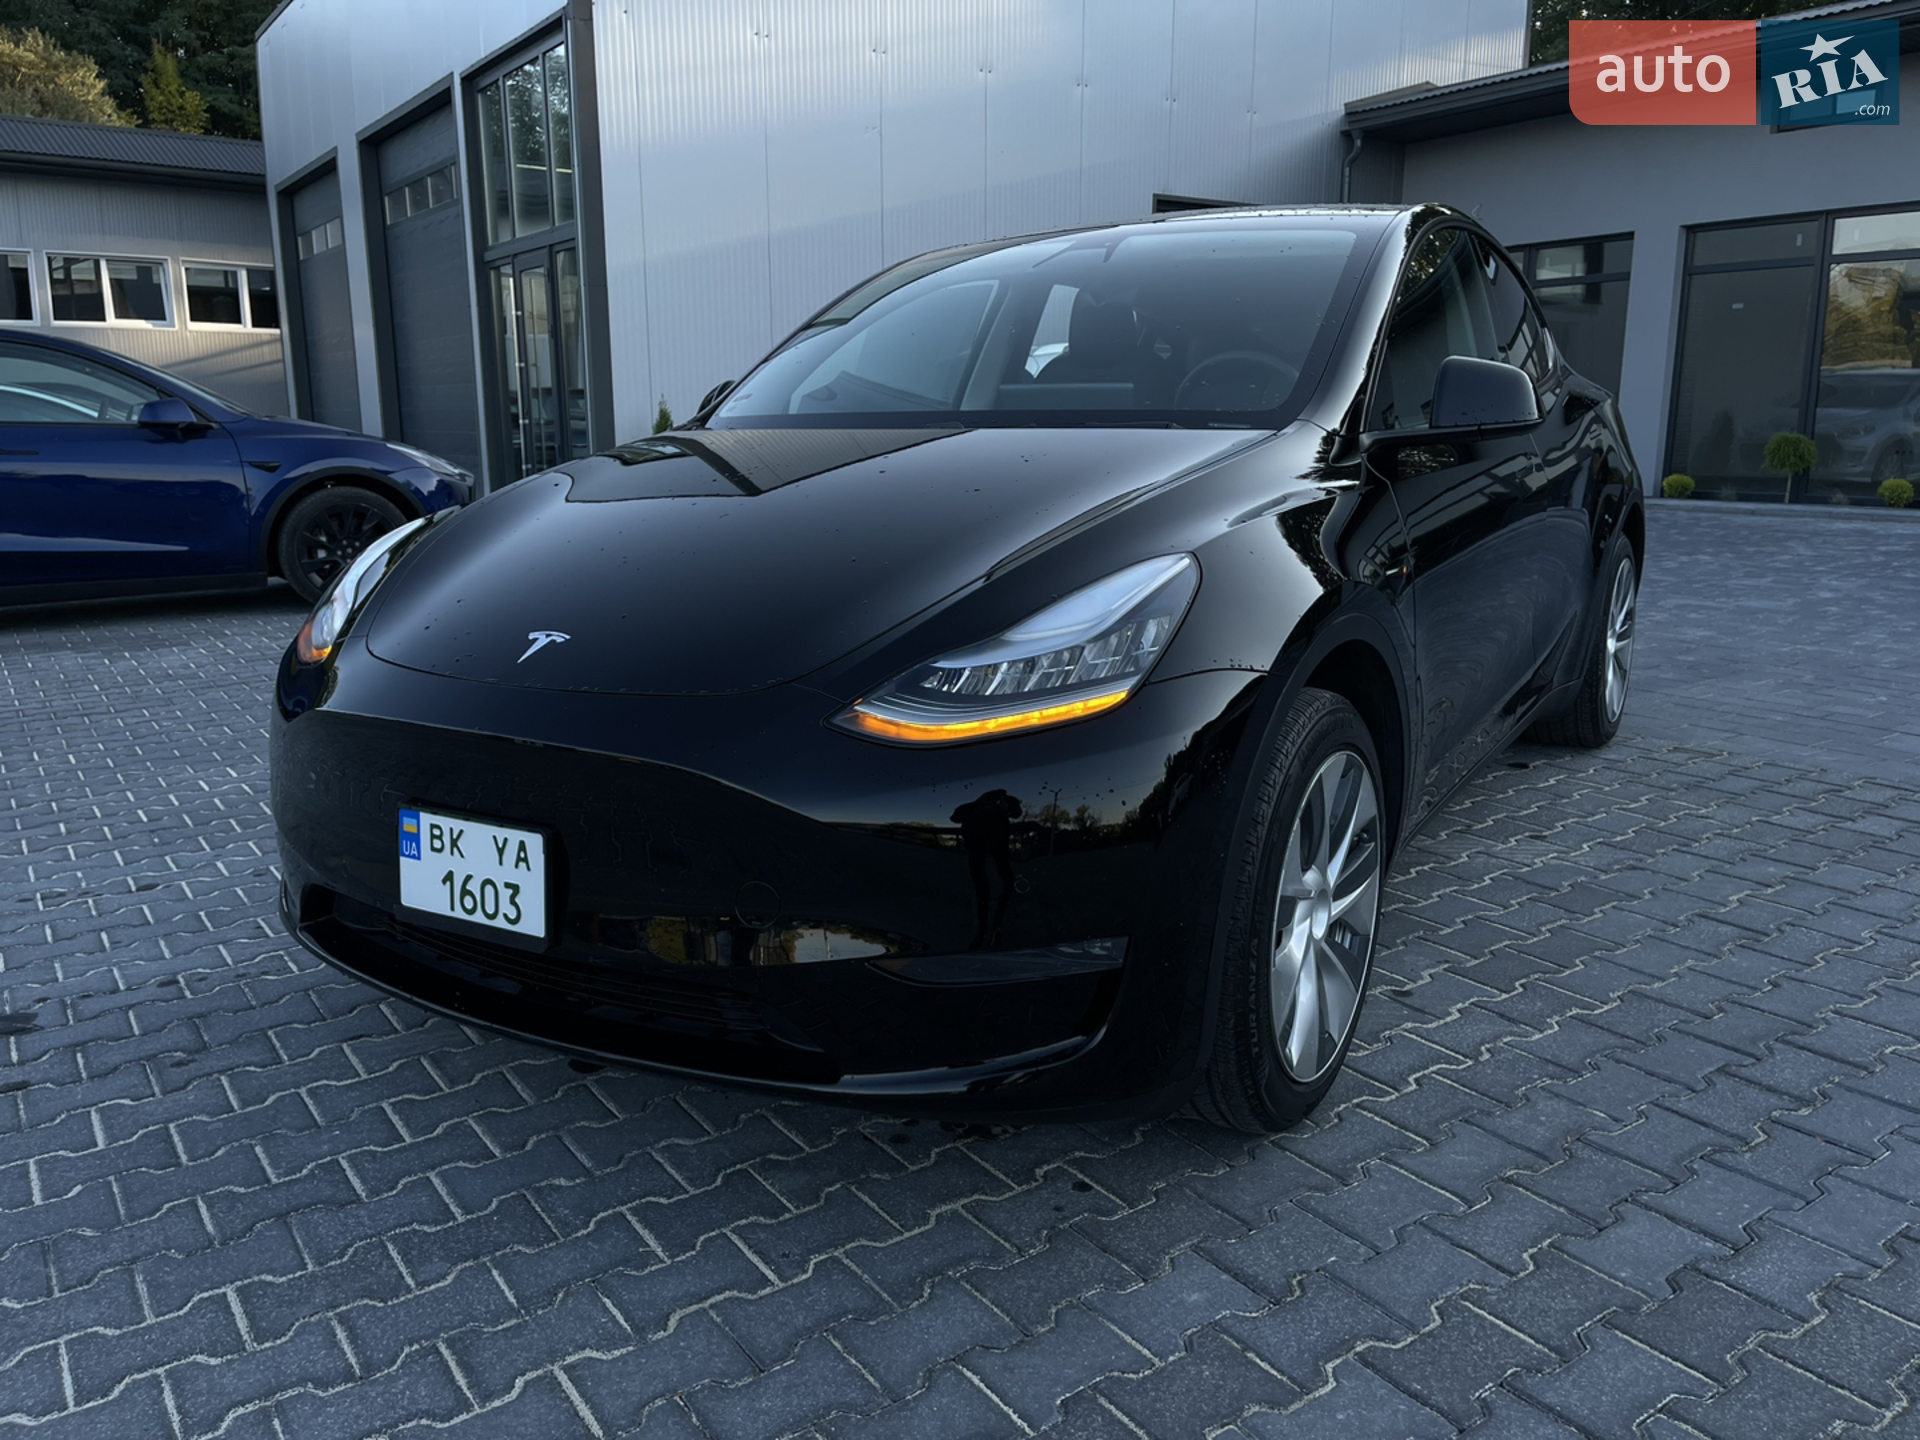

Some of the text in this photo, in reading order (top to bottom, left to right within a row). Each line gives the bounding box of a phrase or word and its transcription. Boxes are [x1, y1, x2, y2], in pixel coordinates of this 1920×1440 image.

[402, 840, 419, 857] UA
[429, 823, 531, 872] BK YA
[441, 869, 522, 926] 1603
[1247, 937, 1261, 1057] TURANZA
